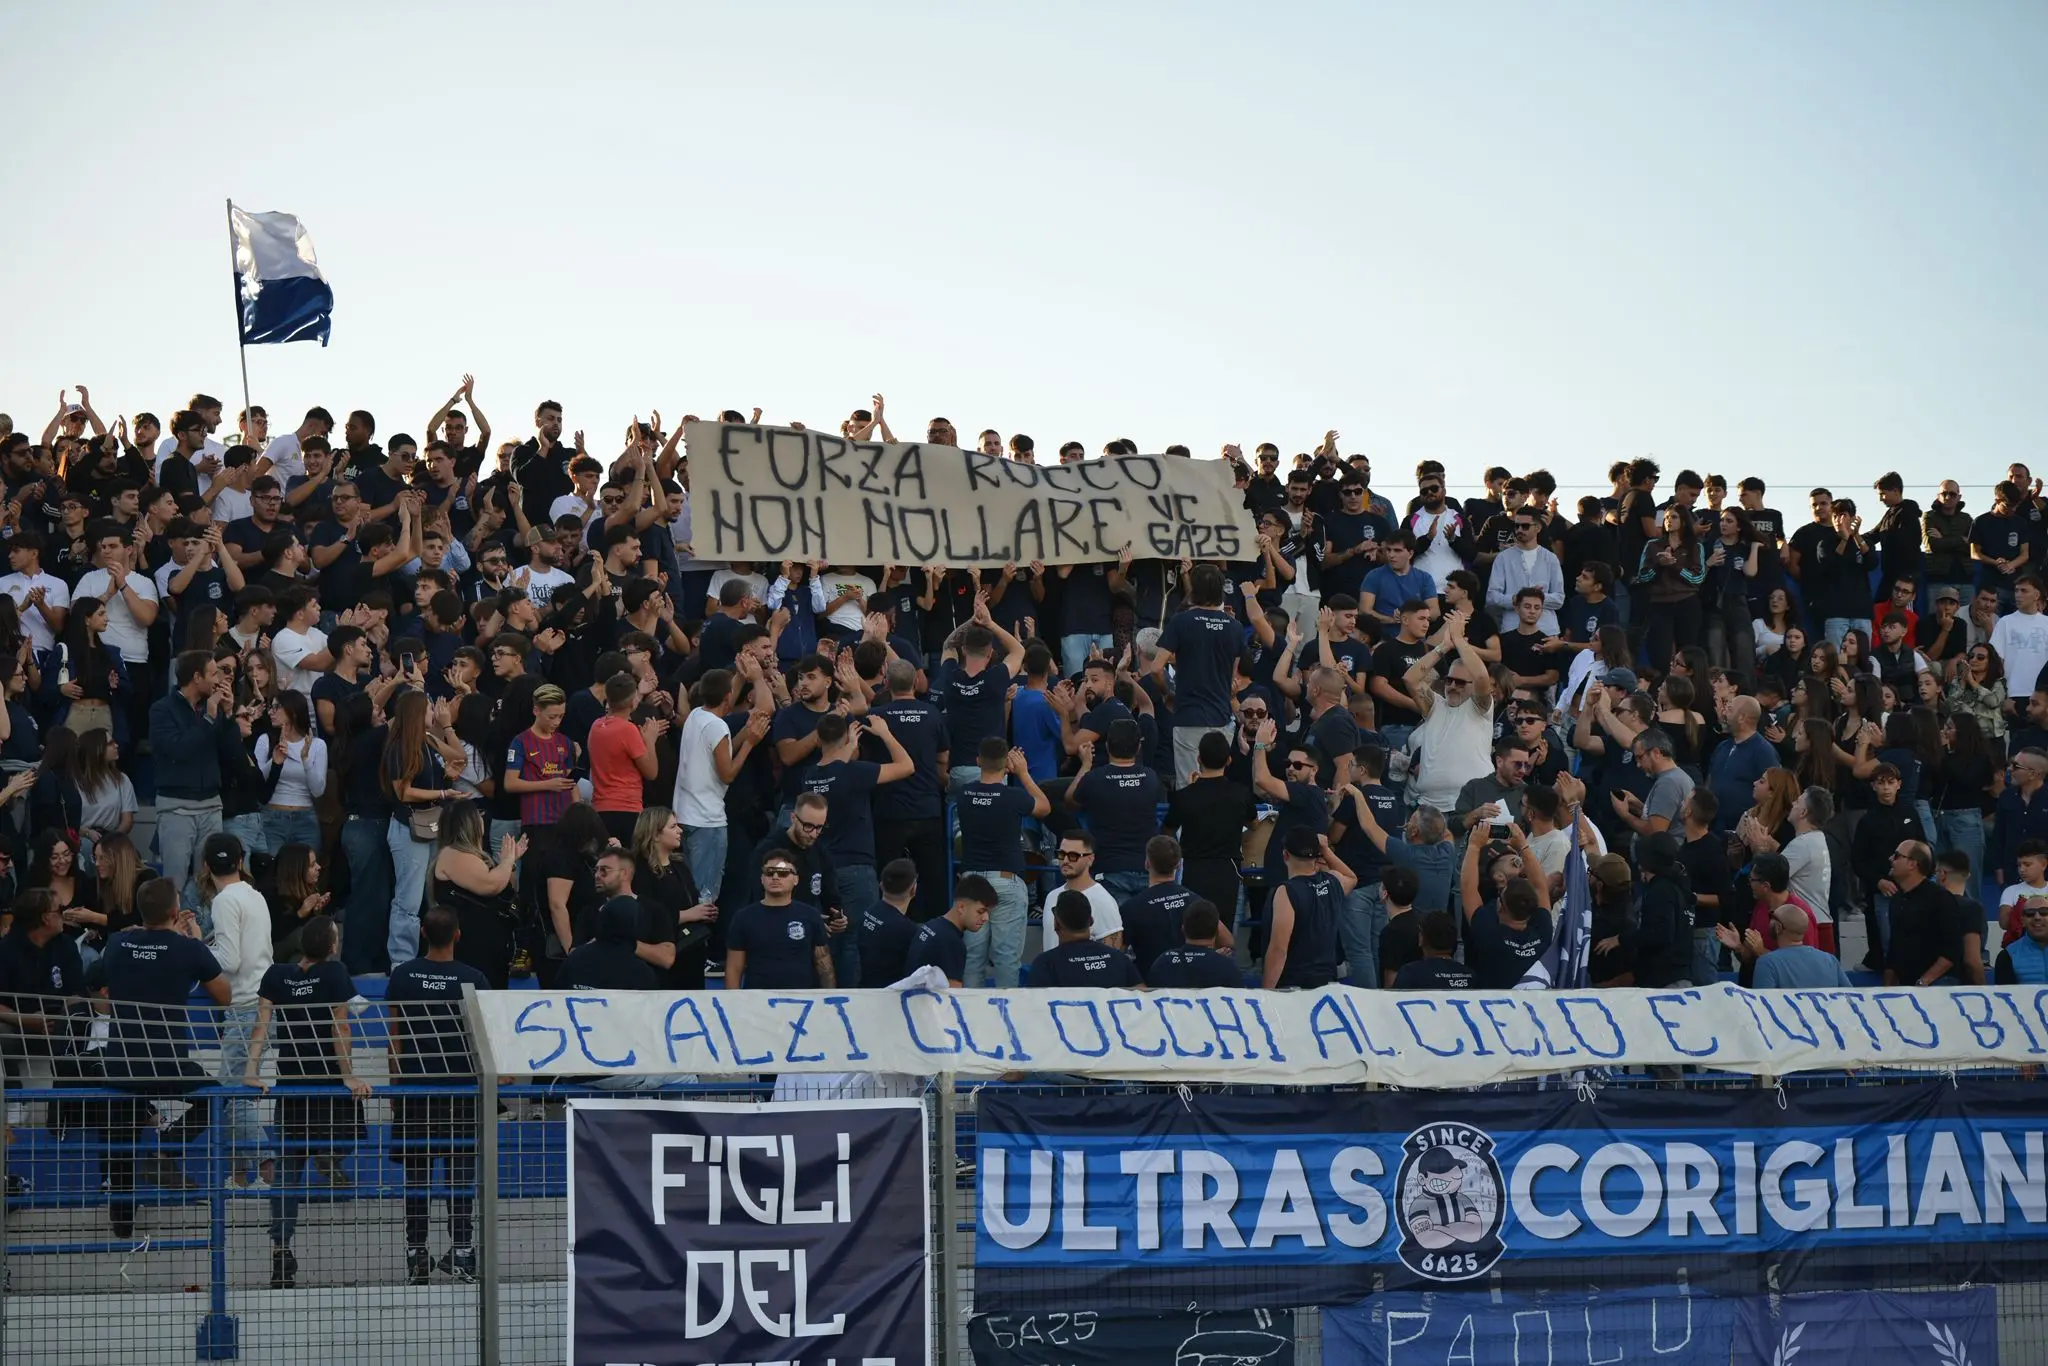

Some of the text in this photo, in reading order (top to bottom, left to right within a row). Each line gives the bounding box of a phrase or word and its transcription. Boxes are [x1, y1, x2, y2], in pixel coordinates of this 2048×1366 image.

[719, 426, 1162, 499] FORZA ROCCO
[711, 489, 827, 559] NON
[515, 996, 636, 1070] SE
[664, 997, 869, 1065] ALZI
[901, 988, 1032, 1061] GLI
[1048, 996, 1287, 1062] OCCHI
[1396, 998, 1626, 1059] CIELO
[1724, 986, 1939, 1052] TUTTO
[1950, 989, 2048, 1054] BI
[1416, 1128, 1486, 1154] SINCE
[982, 1131, 2046, 1250] ULTRAS CORIGLIAN
[685, 1249, 846, 1339] DEL
[1421, 1253, 1478, 1273] 6A25
[987, 1311, 1098, 1349] 6A25
